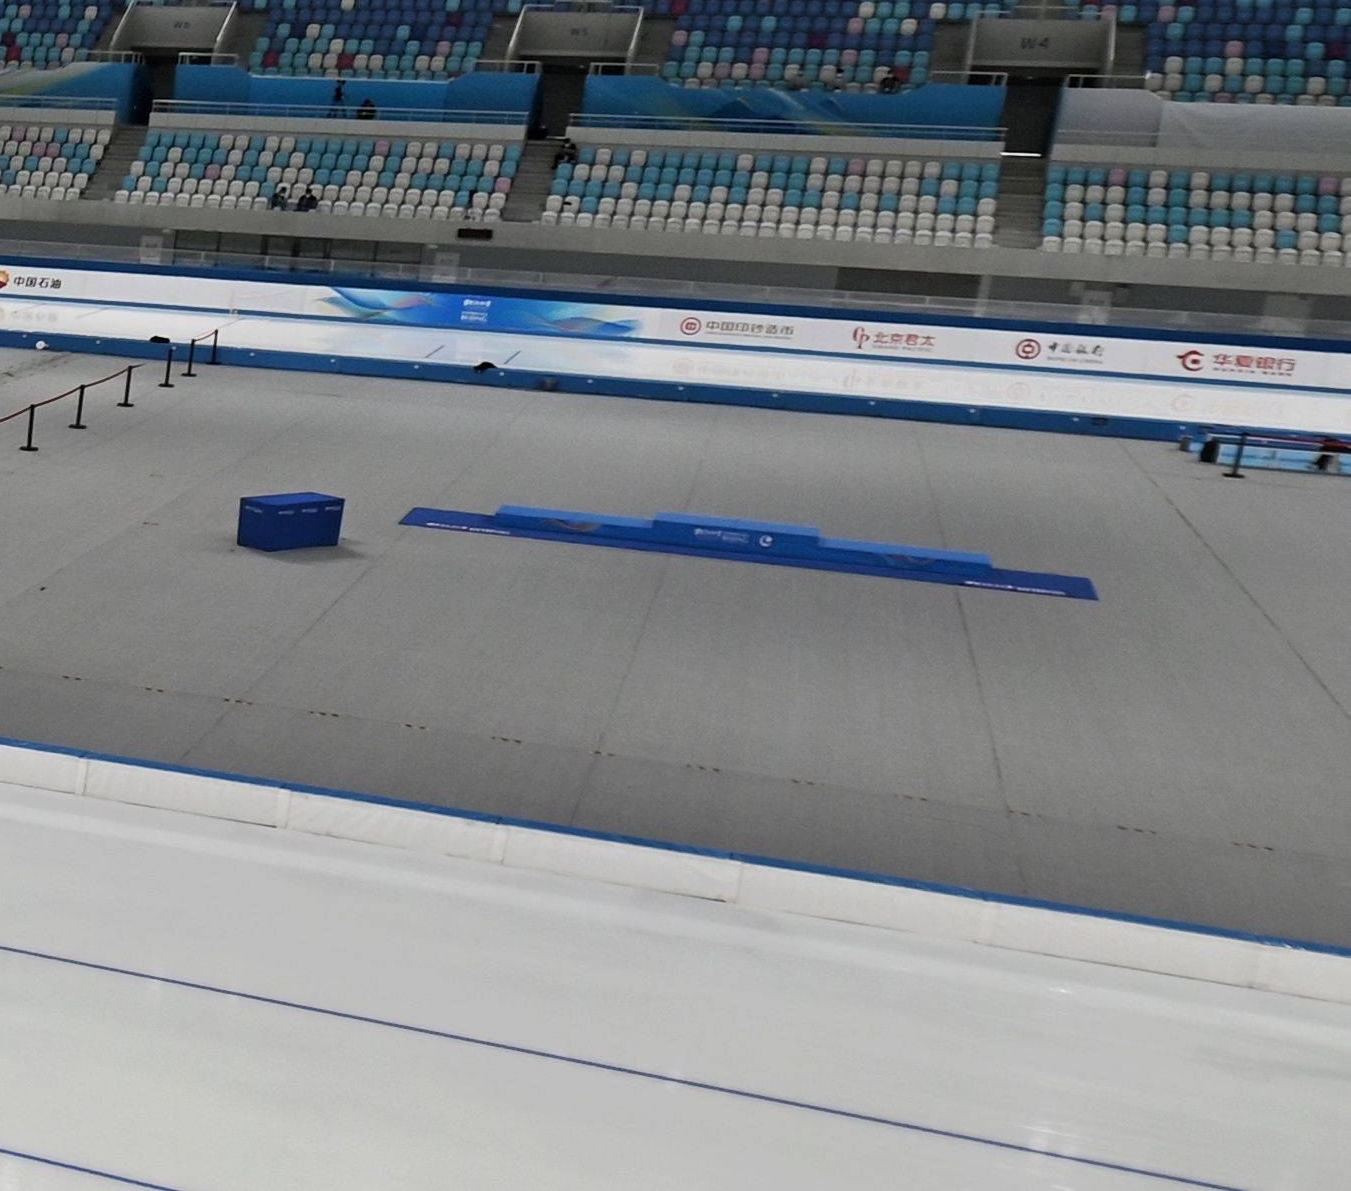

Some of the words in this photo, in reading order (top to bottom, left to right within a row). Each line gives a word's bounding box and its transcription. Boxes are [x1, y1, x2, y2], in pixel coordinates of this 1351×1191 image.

[1020, 37, 1050, 49] W4
[13, 276, 62, 290] 中国石油
[1213, 352, 1296, 372] 华夏银行
